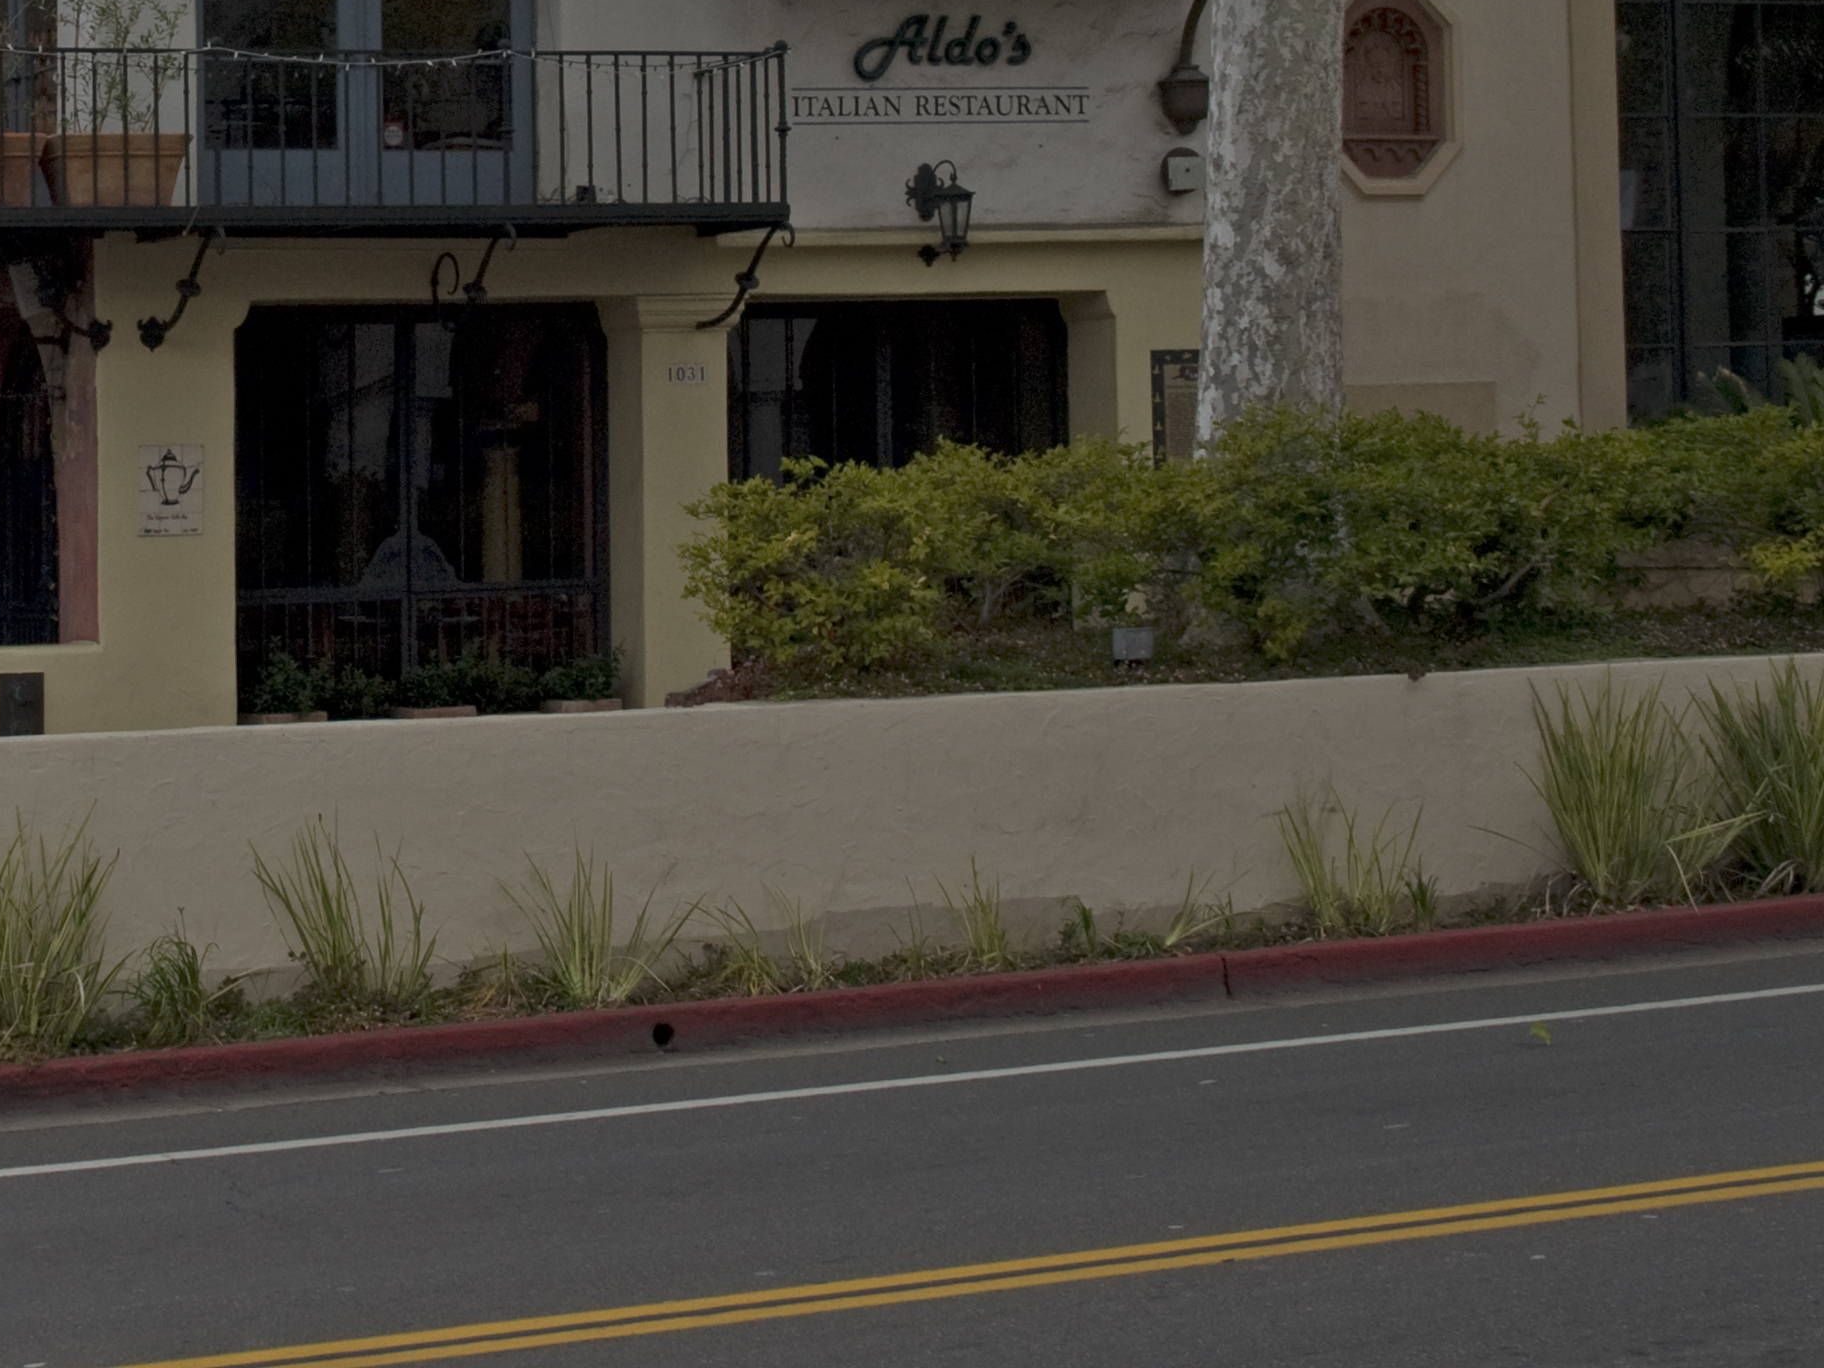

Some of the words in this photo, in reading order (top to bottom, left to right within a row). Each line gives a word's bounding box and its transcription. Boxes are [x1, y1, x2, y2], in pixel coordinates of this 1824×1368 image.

[853, 14, 1033, 83] Aldo's
[792, 95, 902, 117] ITALIAN
[914, 94, 1090, 117] RESTAURANT
[668, 366, 705, 382] 1031
